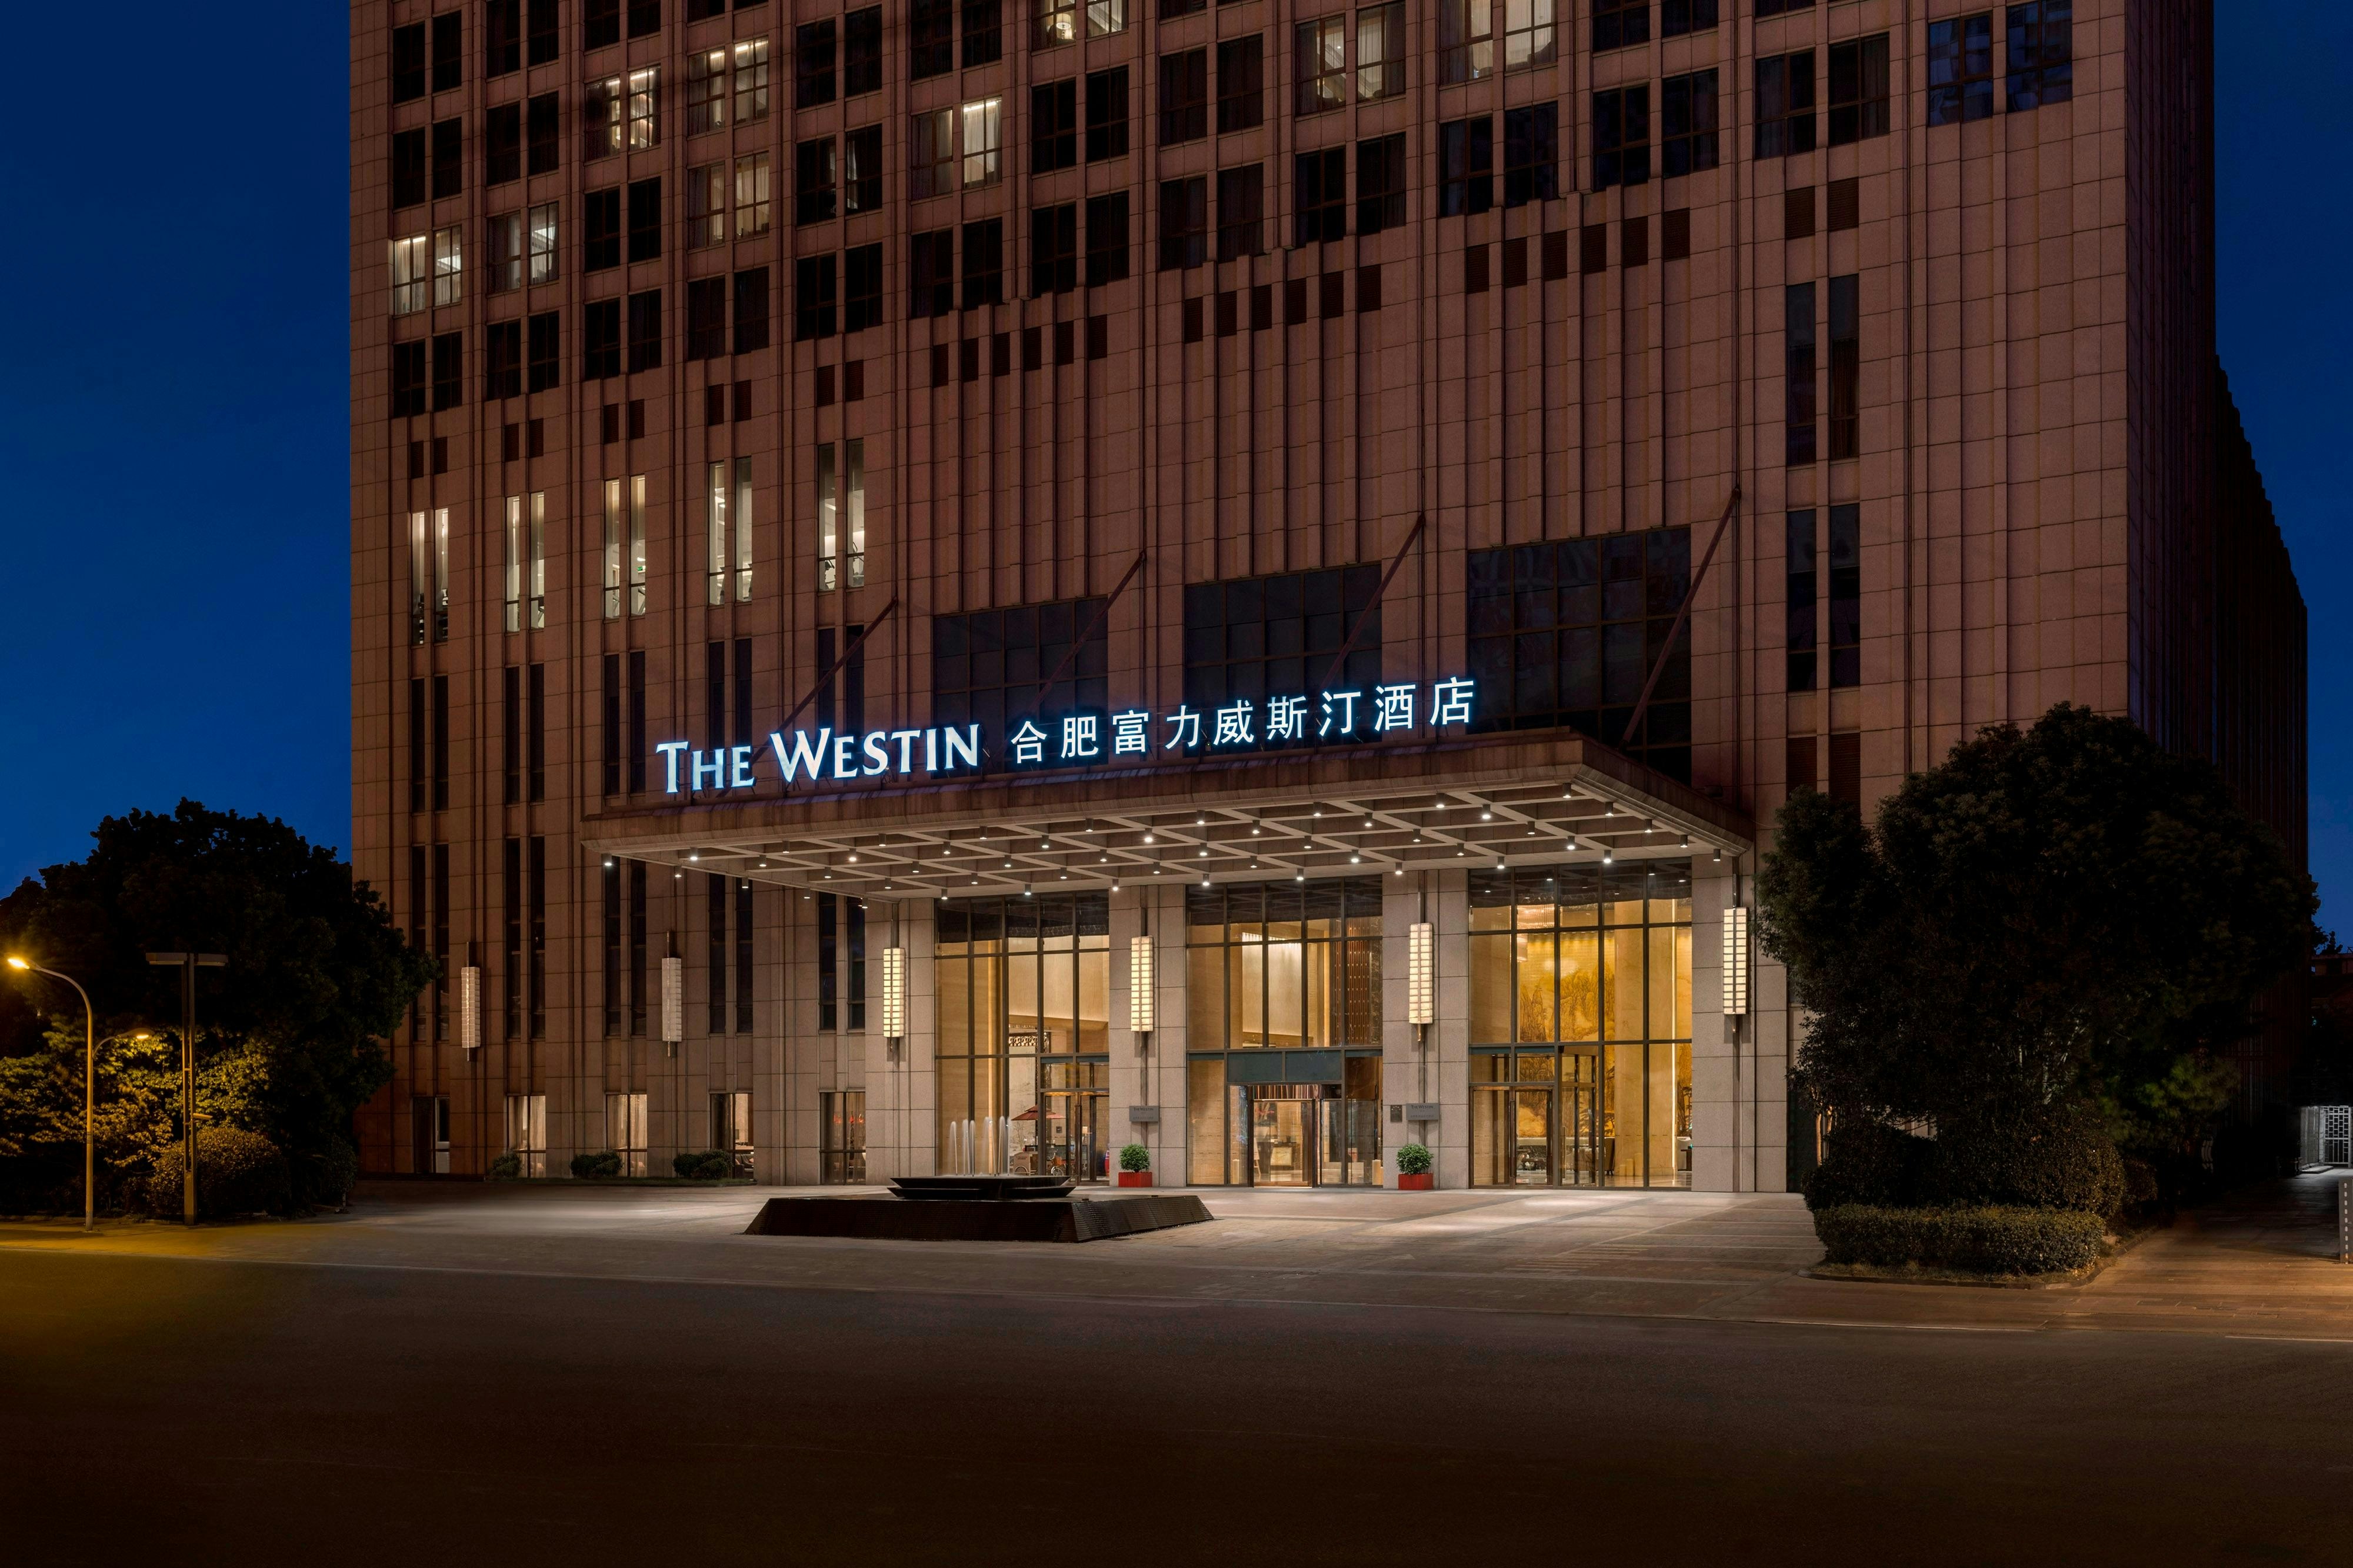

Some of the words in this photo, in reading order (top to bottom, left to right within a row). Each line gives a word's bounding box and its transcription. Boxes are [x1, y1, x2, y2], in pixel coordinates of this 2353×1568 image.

[656, 741, 755, 793] THE
[770, 724, 979, 782] WESTIN
[1011, 676, 1474, 764] 合肥富力威斯汀酒店
